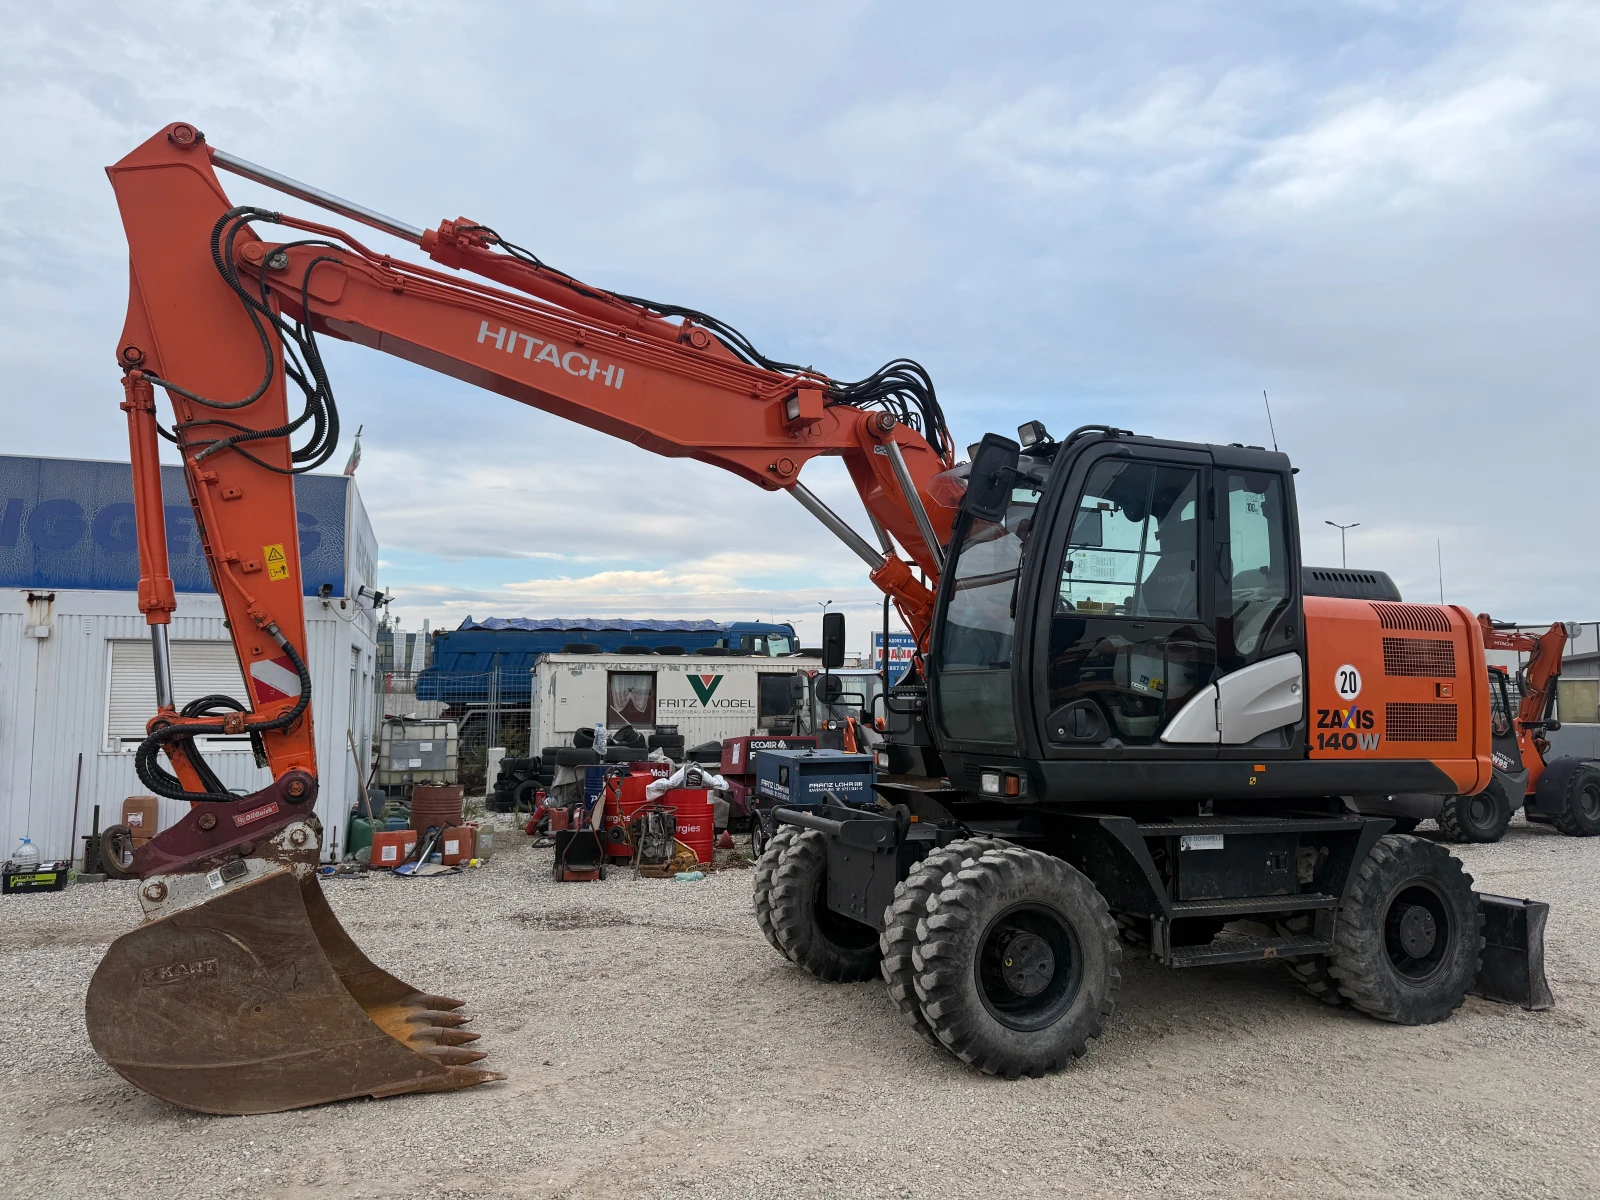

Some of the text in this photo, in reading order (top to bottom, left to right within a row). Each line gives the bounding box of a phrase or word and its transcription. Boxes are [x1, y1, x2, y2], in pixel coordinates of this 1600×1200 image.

[477, 320, 625, 389] HITACHI
[1340, 670, 1357, 693] 20
[658, 699, 756, 708] FRITZ VOGEL
[1317, 705, 1375, 729] ZAXIS
[750, 741, 777, 749] ECOAIR
[1317, 732, 1381, 750] 140W
[1491, 753, 1508, 769] W95
[650, 768, 669, 778] Mobil
[246, 807, 273, 821] OilQuick
